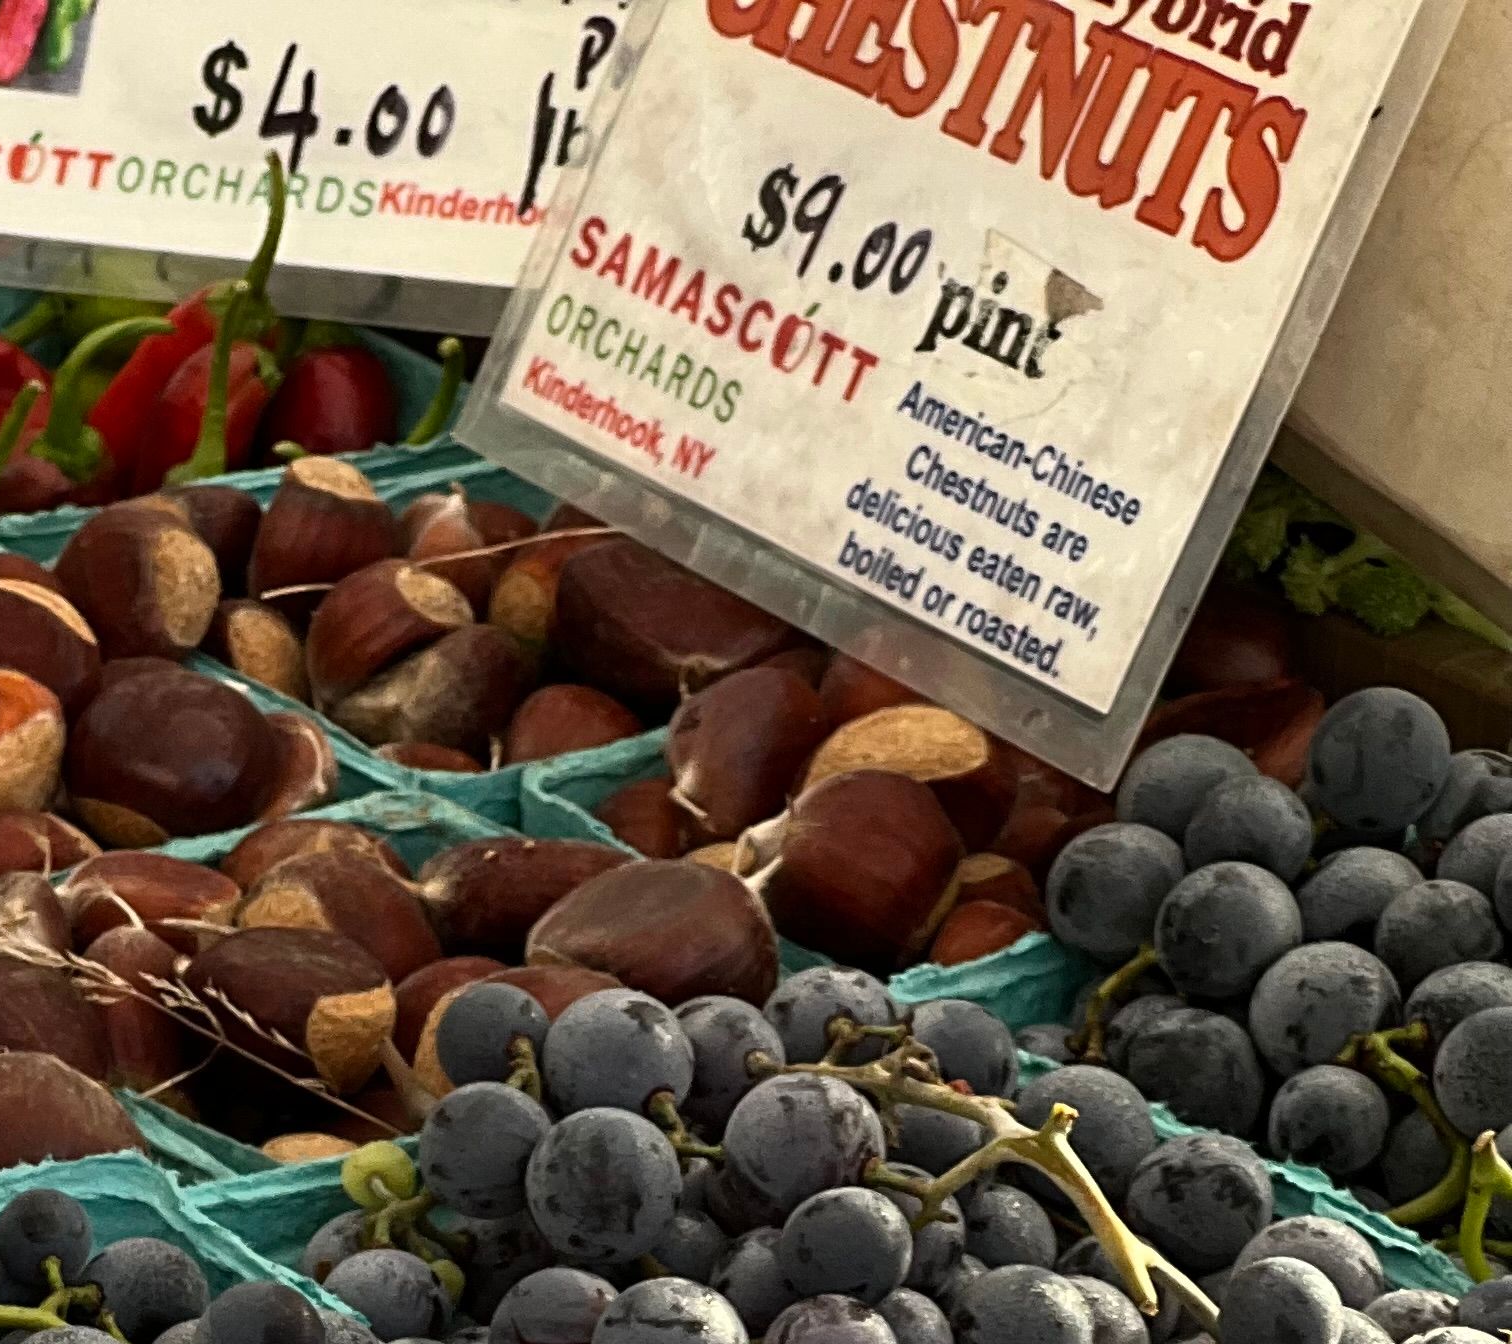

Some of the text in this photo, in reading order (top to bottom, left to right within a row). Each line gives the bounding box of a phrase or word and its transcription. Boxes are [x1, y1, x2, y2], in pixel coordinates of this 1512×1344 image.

[1095, 0, 1310, 77] rid
[193, 41, 455, 172] $4.00
[706, 0, 1306, 262] ESTNUTS
[379, 182, 546, 226] Kinderho
[742, 162, 932, 292] $9.00
[547, 295, 743, 423] ORCHARDS
[570, 216, 879, 401] SAMASCOTT
[524, 357, 717, 478] Kinderhook, NY
[897, 381, 1141, 525] American-Chinese
[846, 478, 1099, 641] delicious eaten raw,
[906, 445, 1088, 562] Chestnuts are
[838, 531, 1062, 678] boiled or roasted.
